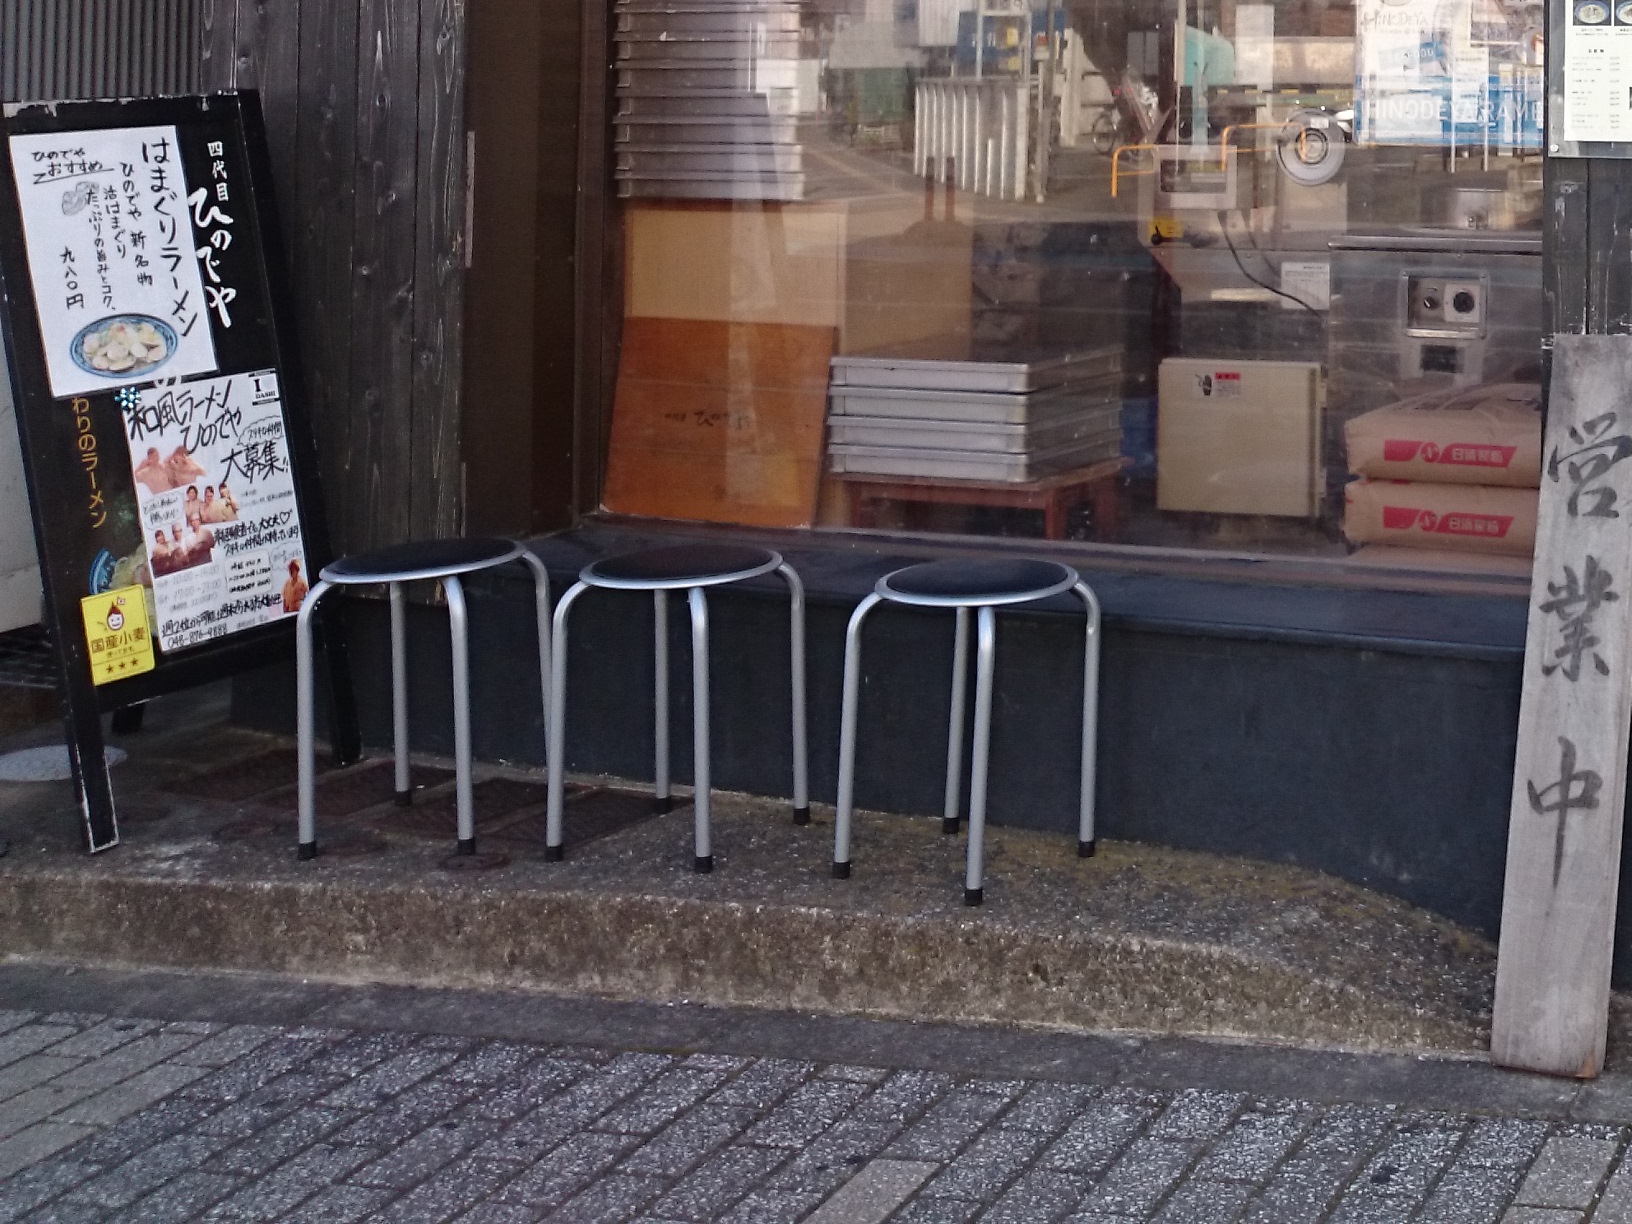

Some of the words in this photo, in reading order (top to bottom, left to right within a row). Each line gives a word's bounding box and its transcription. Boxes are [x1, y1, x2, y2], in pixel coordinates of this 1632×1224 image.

[207, 141, 229, 202] 四代目
[142, 137, 198, 337] はまぐりラーメン
[188, 187, 237, 329] ひのでや
[91, 627, 146, 653] 国産小麦
